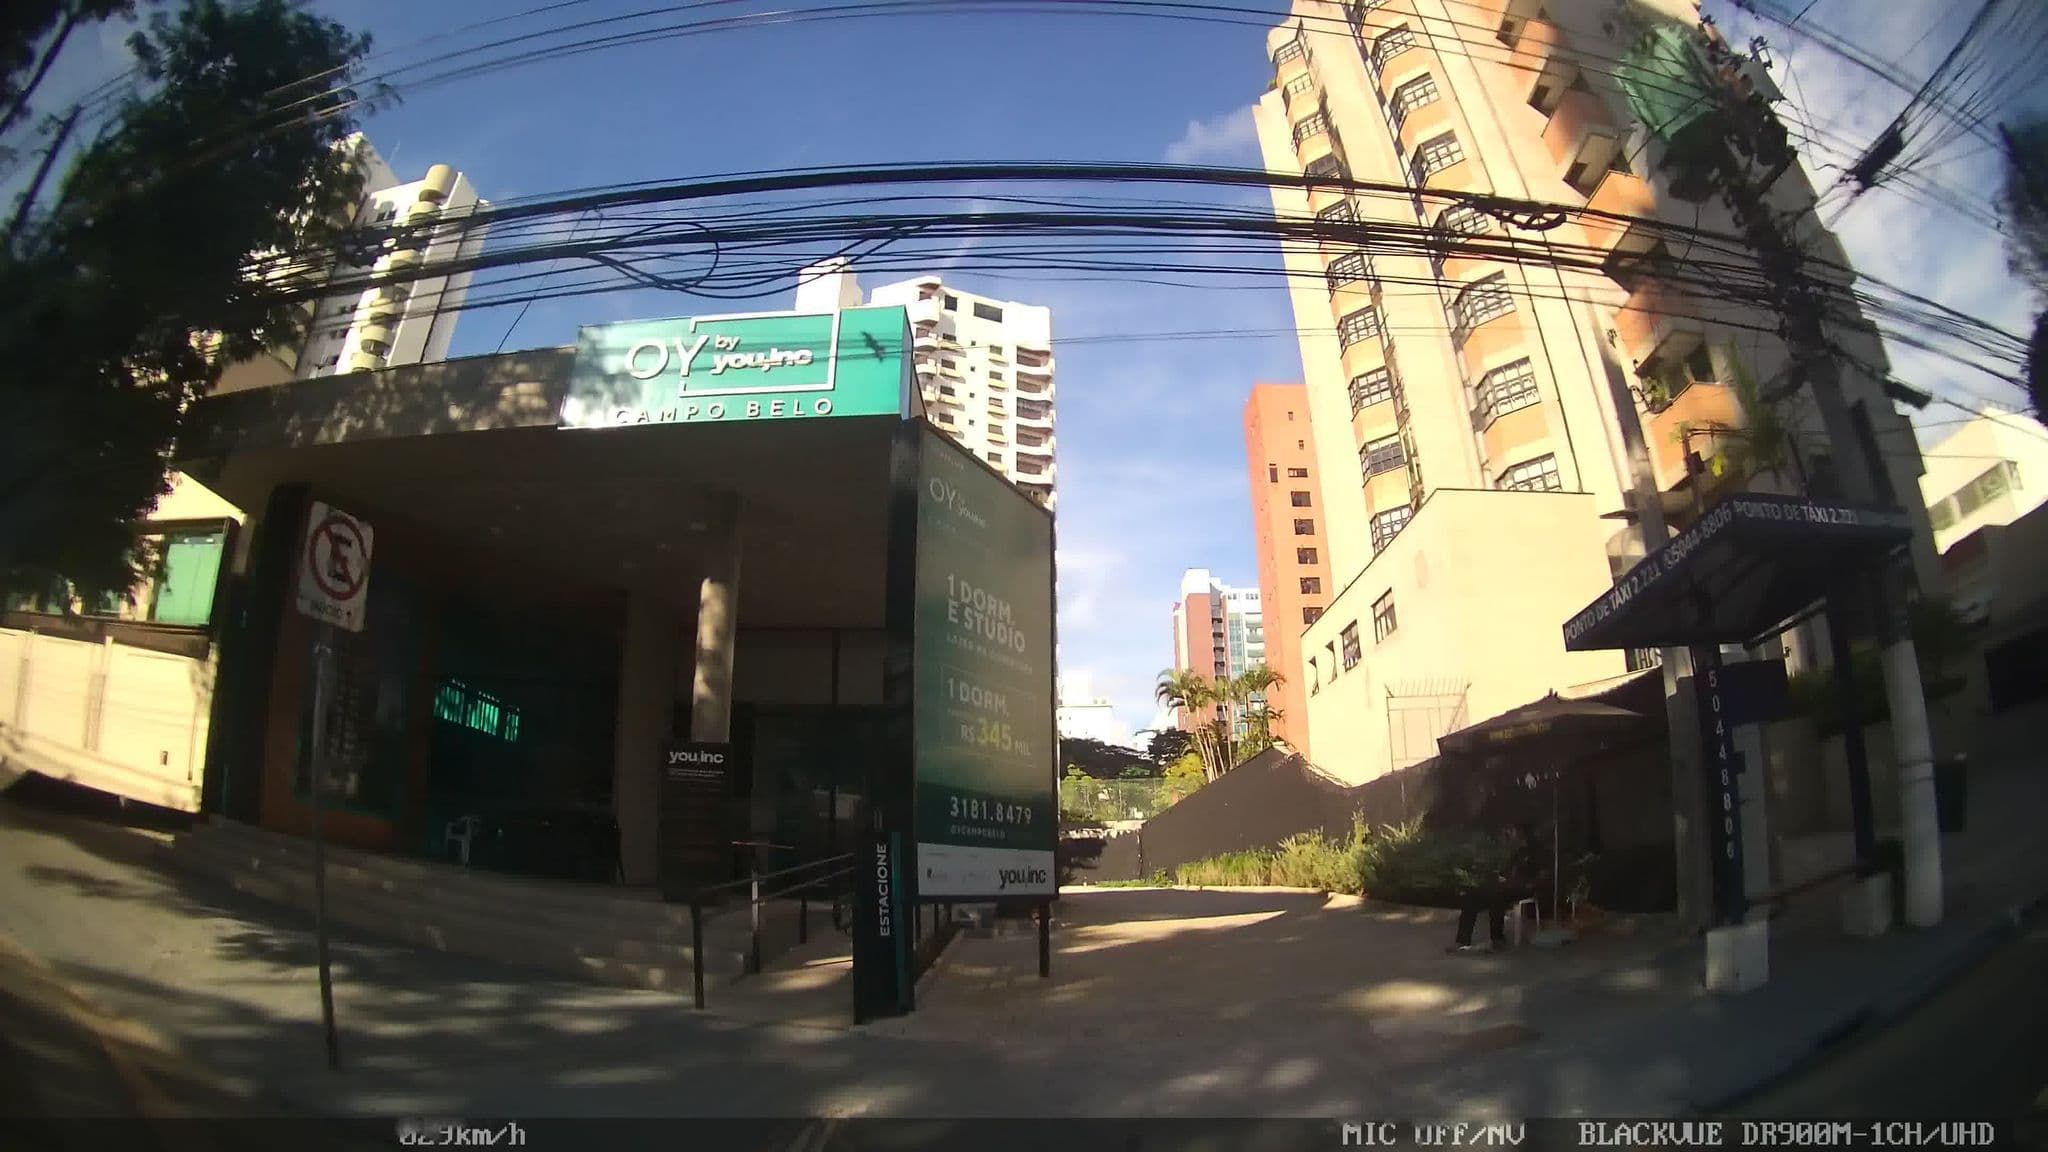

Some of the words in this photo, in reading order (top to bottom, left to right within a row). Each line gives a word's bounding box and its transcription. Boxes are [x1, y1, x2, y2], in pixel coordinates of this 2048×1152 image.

[624, 335, 709, 379] OY
[715, 334, 740, 351] by
[615, 401, 726, 425] CAMPO
[747, 398, 833, 417] BELO
[1733, 500, 1780, 520] PONTO
[1565, 611, 1595, 641] PONTO
[950, 795, 1032, 825] 3181.8479
[876, 842, 890, 936] ESTACIONE
